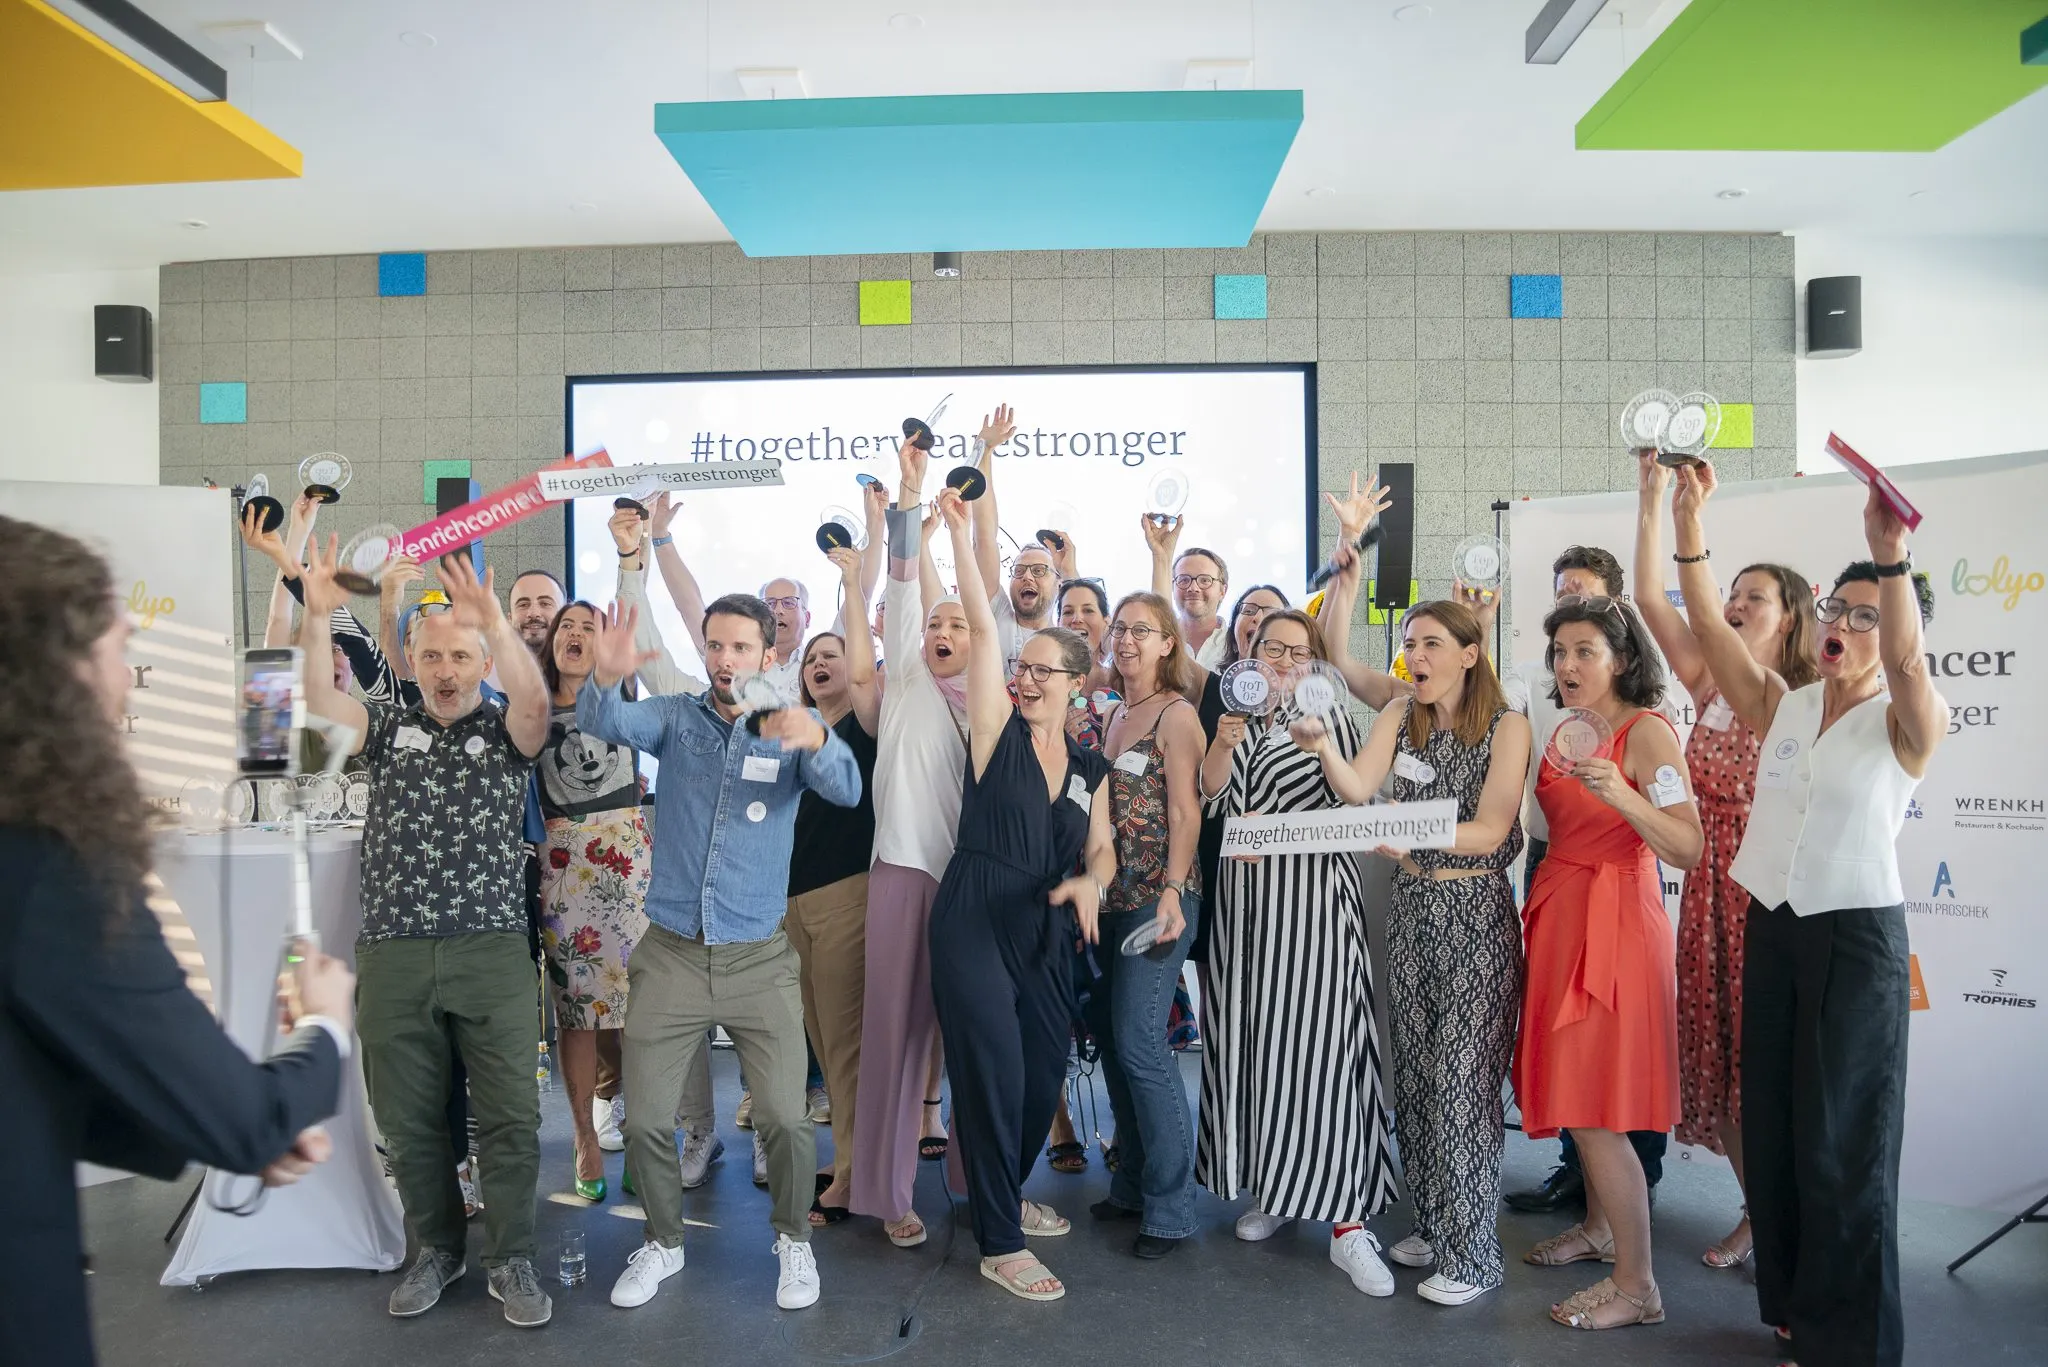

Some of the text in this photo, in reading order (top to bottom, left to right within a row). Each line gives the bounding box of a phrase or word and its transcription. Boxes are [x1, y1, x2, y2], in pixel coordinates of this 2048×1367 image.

[1955, 797, 2044, 813] WRENKH
[1226, 816, 1451, 850] #togetherwearestronger
[1954, 820, 1995, 830] Restaurant
[2005, 822, 2044, 831] Kochsalon
[1904, 901, 1989, 918] RMIN PROSCHEK
[1962, 993, 2037, 1008] TROPHIES
